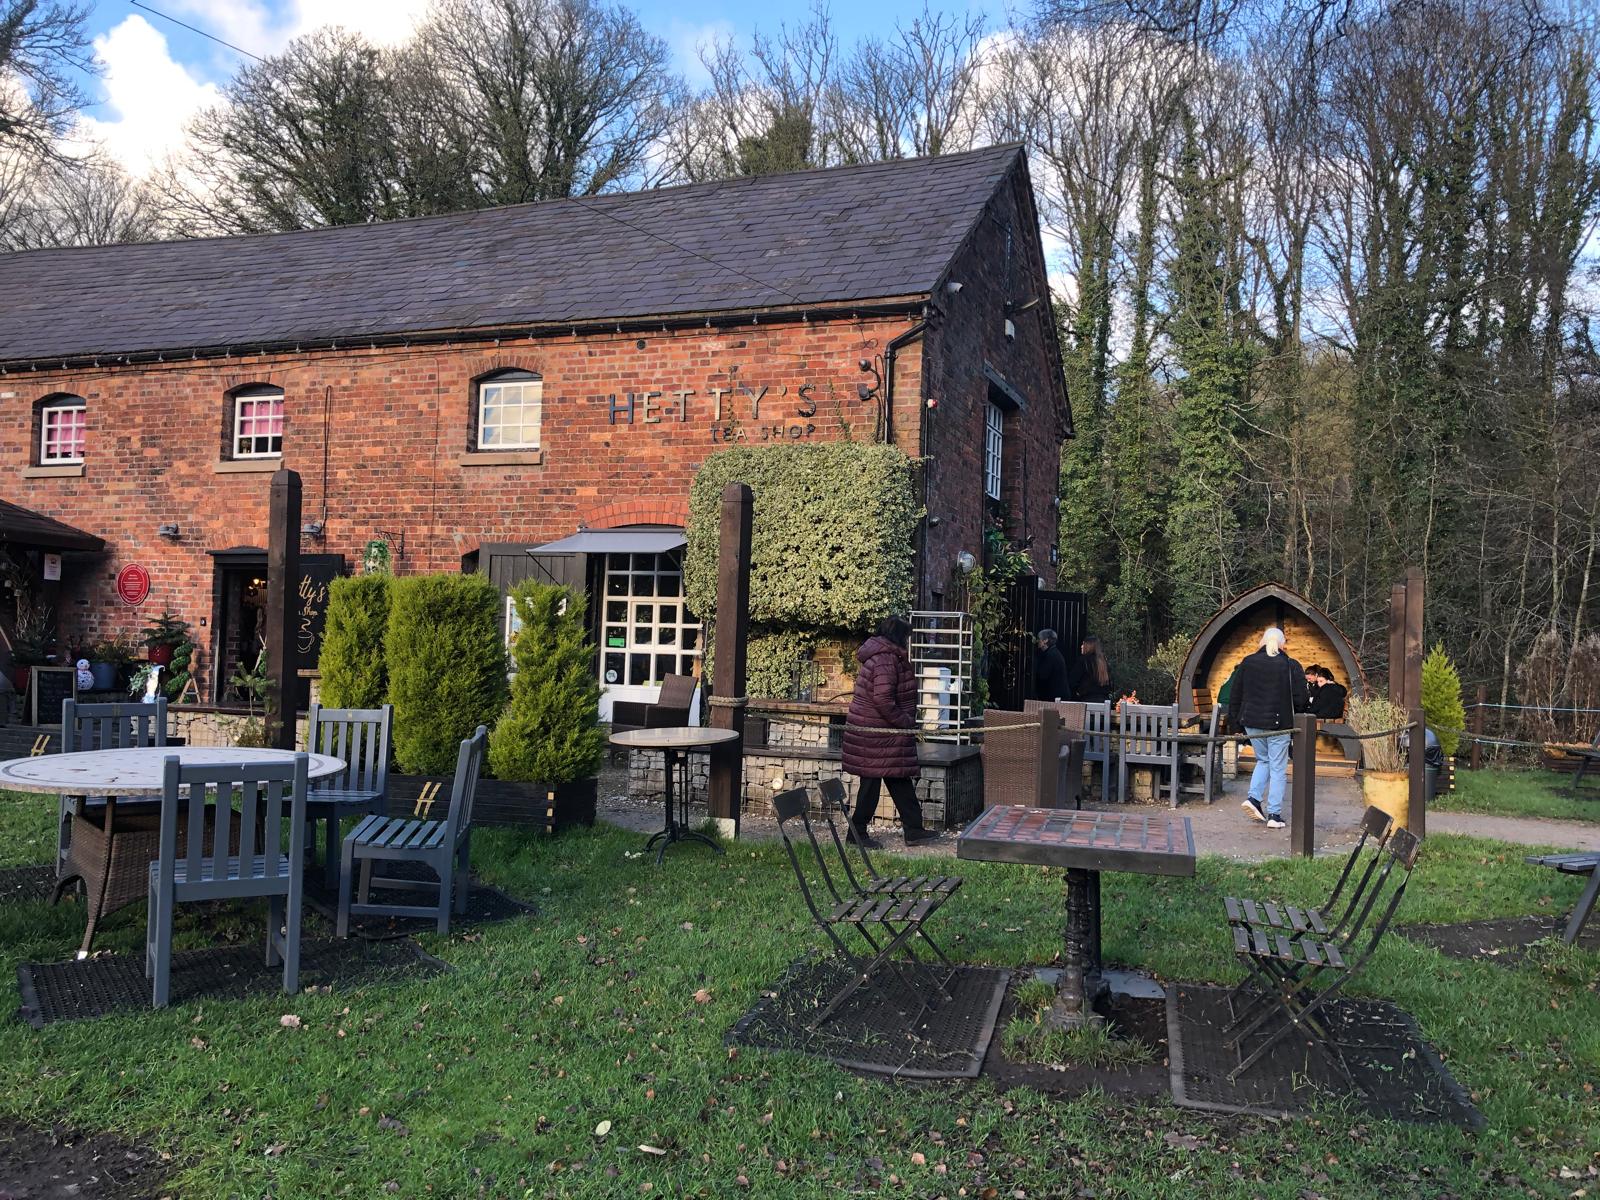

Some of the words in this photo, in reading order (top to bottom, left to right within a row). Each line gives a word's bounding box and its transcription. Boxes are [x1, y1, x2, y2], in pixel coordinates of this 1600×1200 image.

[608, 384, 817, 425] HETTY'S
[710, 427, 748, 443] TEA
[761, 424, 816, 441] SHOP
[299, 574, 325, 606] tty's
